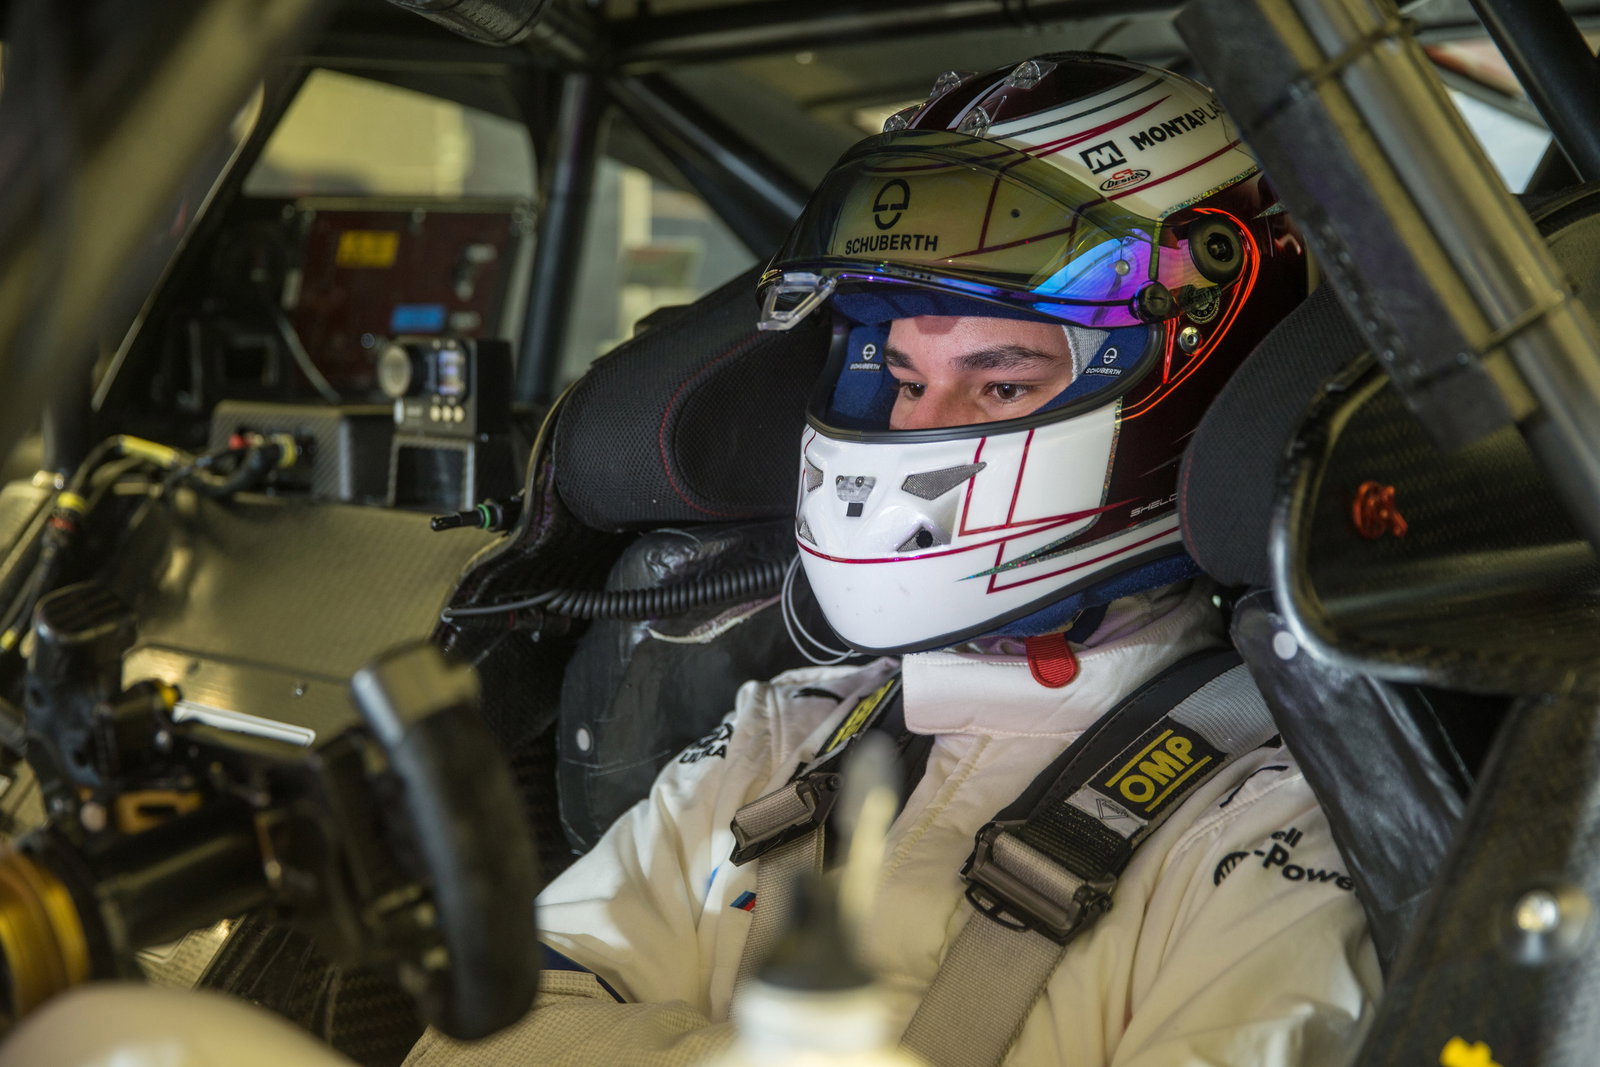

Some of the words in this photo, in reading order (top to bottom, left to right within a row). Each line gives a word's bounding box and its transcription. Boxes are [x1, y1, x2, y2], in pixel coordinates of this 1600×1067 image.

[1129, 100, 1222, 150] MONTAPLA
[845, 234, 939, 255] SCHUBERTH
[1120, 736, 1194, 803] OMP
[1271, 827, 1303, 848] ell
